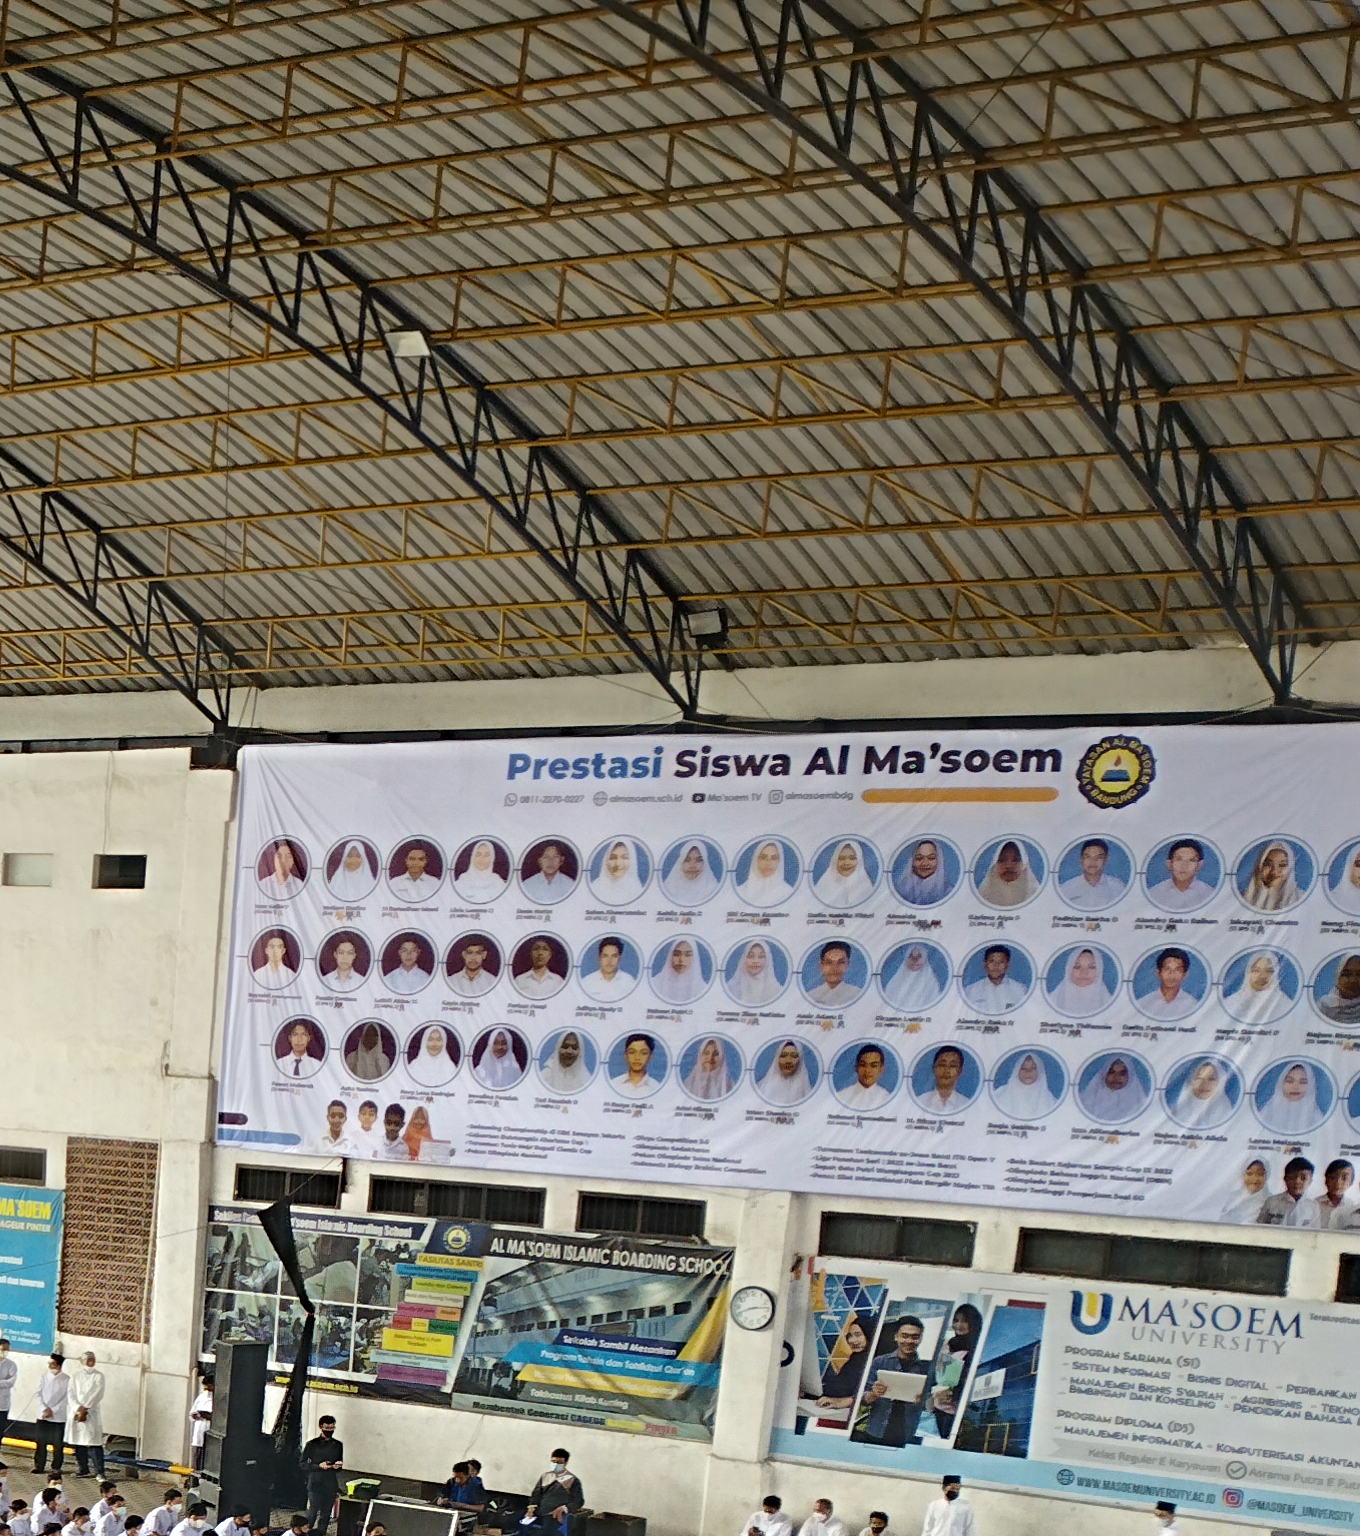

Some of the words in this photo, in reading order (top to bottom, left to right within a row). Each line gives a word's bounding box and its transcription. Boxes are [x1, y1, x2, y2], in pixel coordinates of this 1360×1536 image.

[506, 745, 664, 781] Prestasi
[674, 744, 791, 779] Siswa
[803, 744, 850, 776] Al
[861, 742, 1062, 775] Ma'soem
[751, 793, 762, 802] TV
[490, 1237, 505, 1253] AL
[506, 1238, 561, 1261] MA'SOEM
[563, 1243, 611, 1264] ISLAMIC
[612, 1251, 676, 1272] BOARDING
[677, 1256, 730, 1276] SCHOOL
[1118, 1296, 1304, 1339] MA'SOEM
[540, 1349, 578, 1363] Program
[1064, 1345, 1121, 1360] PROGRAM
[1123, 1351, 1173, 1366] SARJANA
[1131, 1326, 1286, 1355] UNIVERSITY
[1069, 1376, 1135, 1391] MANAJEMEN
[1138, 1382, 1173, 1395] BISNIS
[1176, 1387, 1225, 1401] SYARIAH
[1241, 1395, 1303, 1410] AGRIBISNIS
[1072, 1361, 1111, 1375] SISTEM
[1113, 1365, 1172, 1380] INFORMASI
[1187, 1373, 1222, 1387] BISNIS
[1225, 1377, 1269, 1391] DIGITAL
[1286, 1384, 1358, 1401] PERBANKAN
[1056, 1409, 1112, 1424] PROGRAM
[1114, 1415, 1164, 1431] DIPLOMA
[1069, 1385, 1127, 1400] BIMBINGAN
[1130, 1390, 1154, 1402] DAN
[1156, 1394, 1217, 1410] KONSELING
[1233, 1402, 1302, 1420] PENDIDIKAN
[1304, 1411, 1352, 1426] BAHASA
[1063, 1425, 1130, 1442] MANAJEMEN
[1132, 1431, 1203, 1450] INFORMATIKA
[1216, 1442, 1305, 1462] KOMPUTERISASI
[1118, 1451, 1157, 1467] Reguler
[1169, 1457, 1222, 1475] Karyawan
[1249, 1466, 1291, 1483] Asrama
[1293, 1471, 1324, 1486] Putra
[1076, 1475, 1216, 1506] WWW.MASOEMUNIVERSITY.AC.ID
